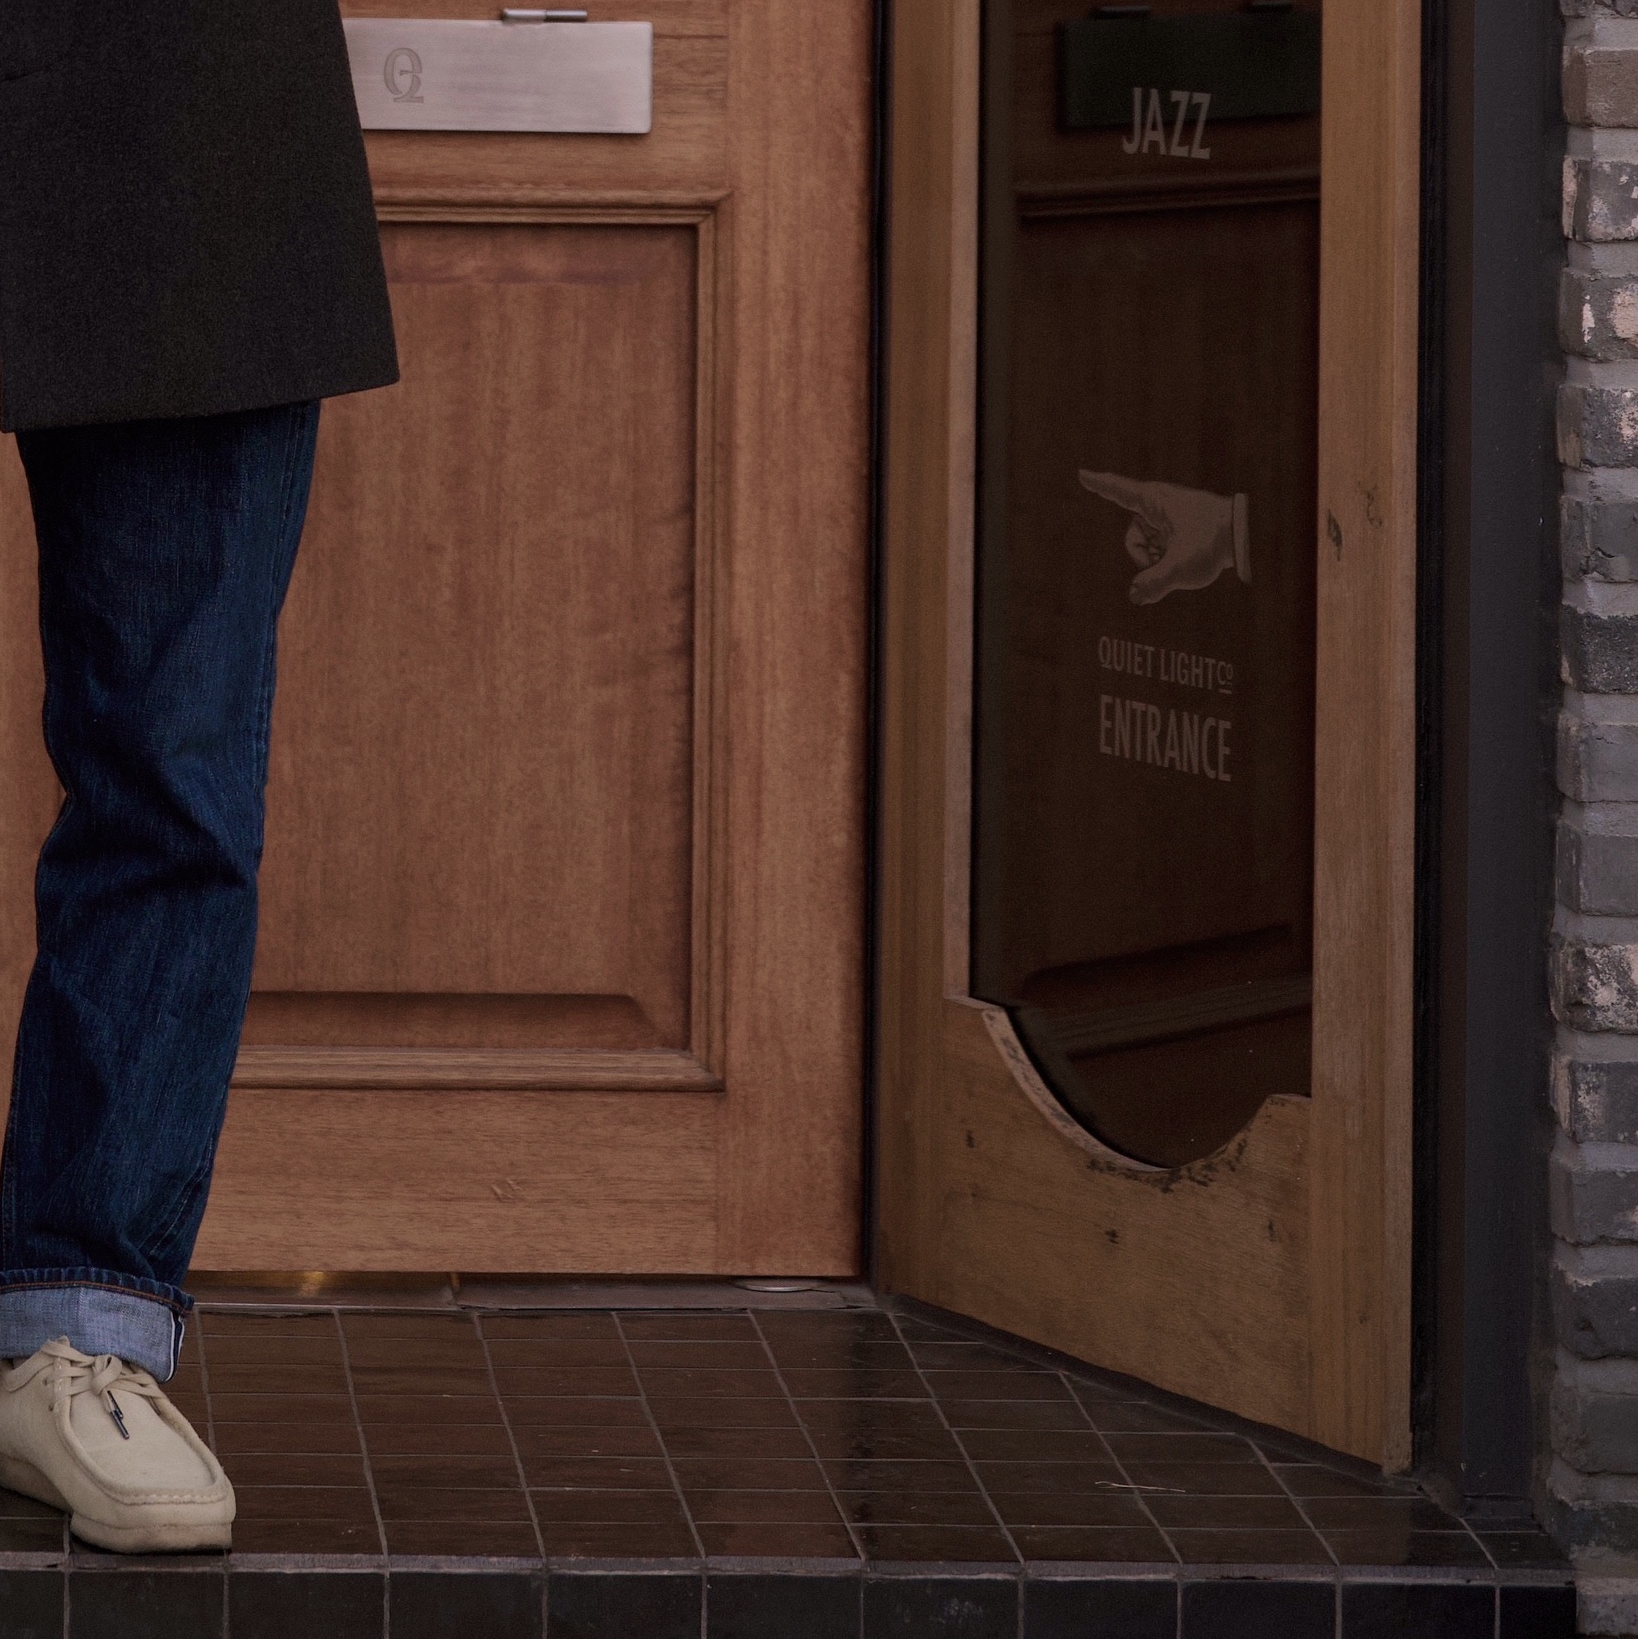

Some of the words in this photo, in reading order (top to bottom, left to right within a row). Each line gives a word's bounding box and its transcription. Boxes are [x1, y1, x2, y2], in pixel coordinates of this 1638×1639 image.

[1122, 87, 1212, 160] JAZZ
[1098, 635, 1155, 678] QUIET
[1159, 648, 1216, 690] LIGHT
[1099, 693, 1232, 783] ENTRANCE
